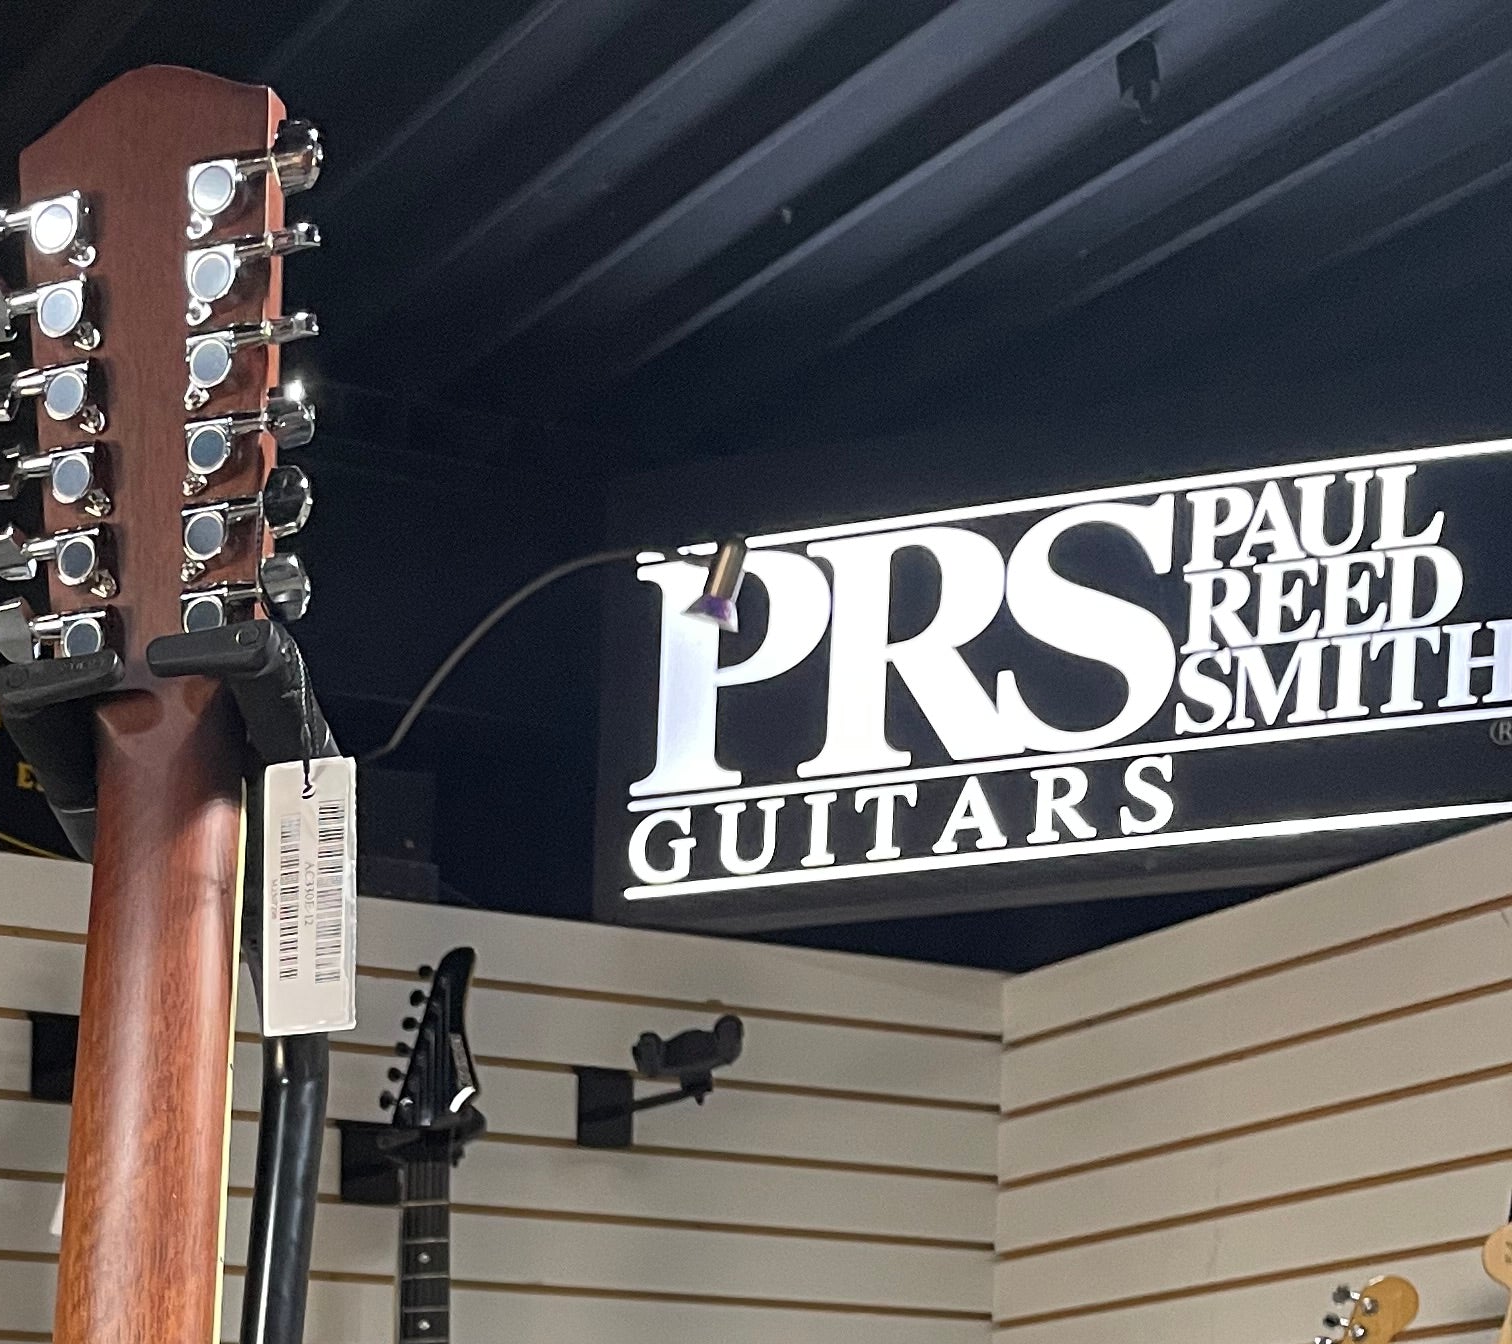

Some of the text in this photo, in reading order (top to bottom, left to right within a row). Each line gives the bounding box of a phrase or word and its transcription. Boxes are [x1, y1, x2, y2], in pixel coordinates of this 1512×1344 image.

[1184, 465, 1445, 571] PAUL
[629, 492, 1176, 797] PRS
[1181, 546, 1464, 654] REED
[1175, 621, 1512, 736] SMITH
[628, 754, 1174, 884] GUITARS
